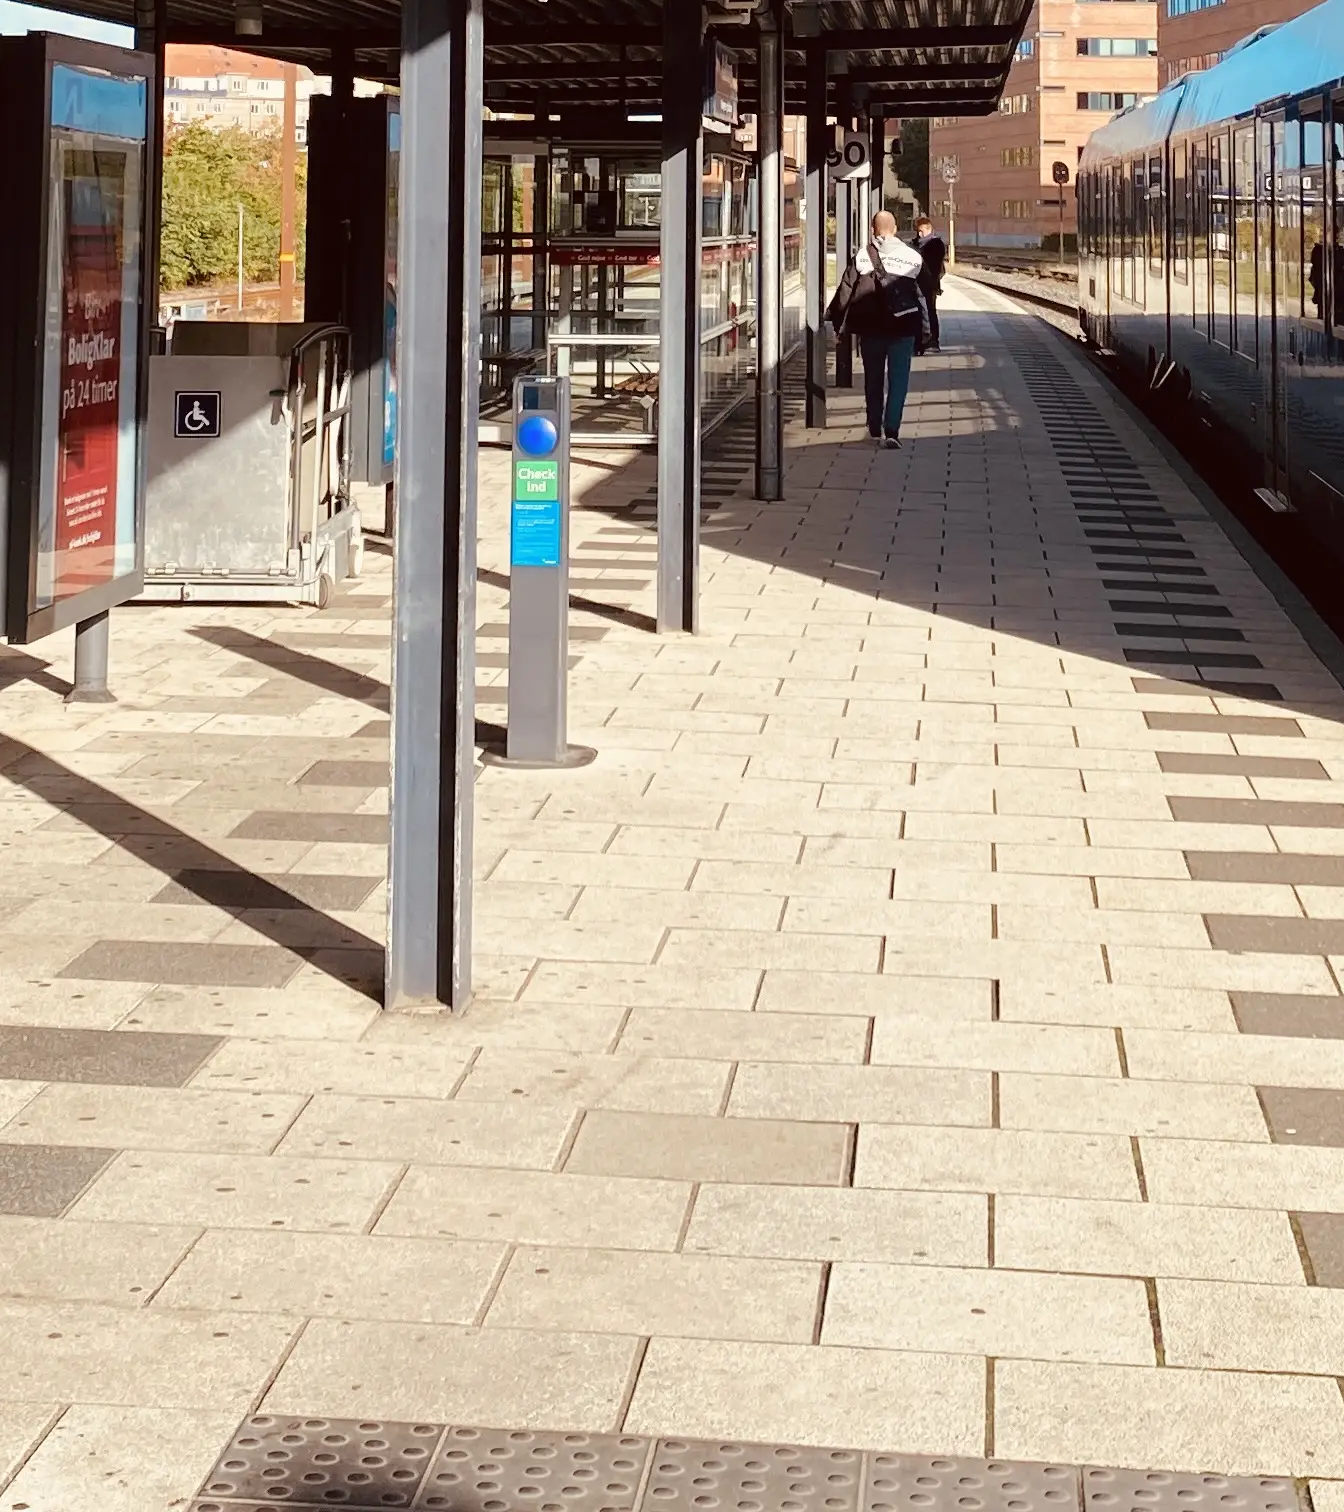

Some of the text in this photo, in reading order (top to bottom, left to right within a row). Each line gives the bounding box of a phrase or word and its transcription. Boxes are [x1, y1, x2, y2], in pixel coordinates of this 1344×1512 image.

[67, 331, 116, 370] BoligKlar
[63, 375, 118, 419] på 24 timer
[518, 468, 556, 480] Check
[526, 480, 547, 492] ind
